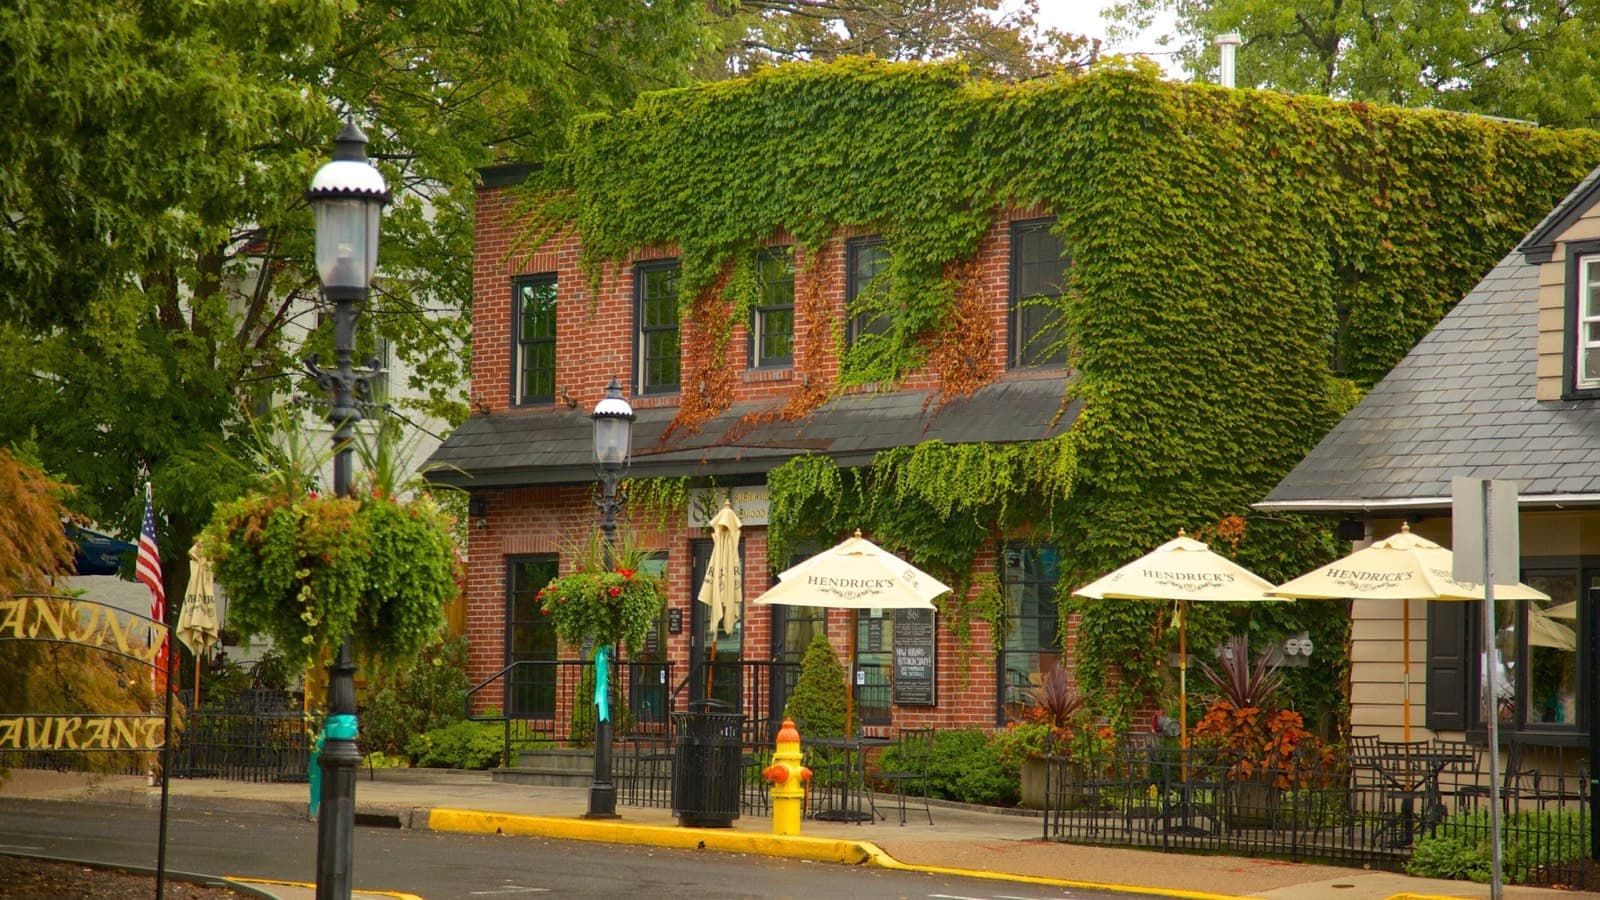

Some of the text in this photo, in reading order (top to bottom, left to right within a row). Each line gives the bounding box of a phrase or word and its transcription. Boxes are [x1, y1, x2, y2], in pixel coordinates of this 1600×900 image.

[807, 575, 895, 588] HENDRICK'S
[1143, 569, 1235, 582] HENDRICK'S
[1326, 568, 1414, 582] HENDRICK'S
[0, 716, 166, 750] AURANT
